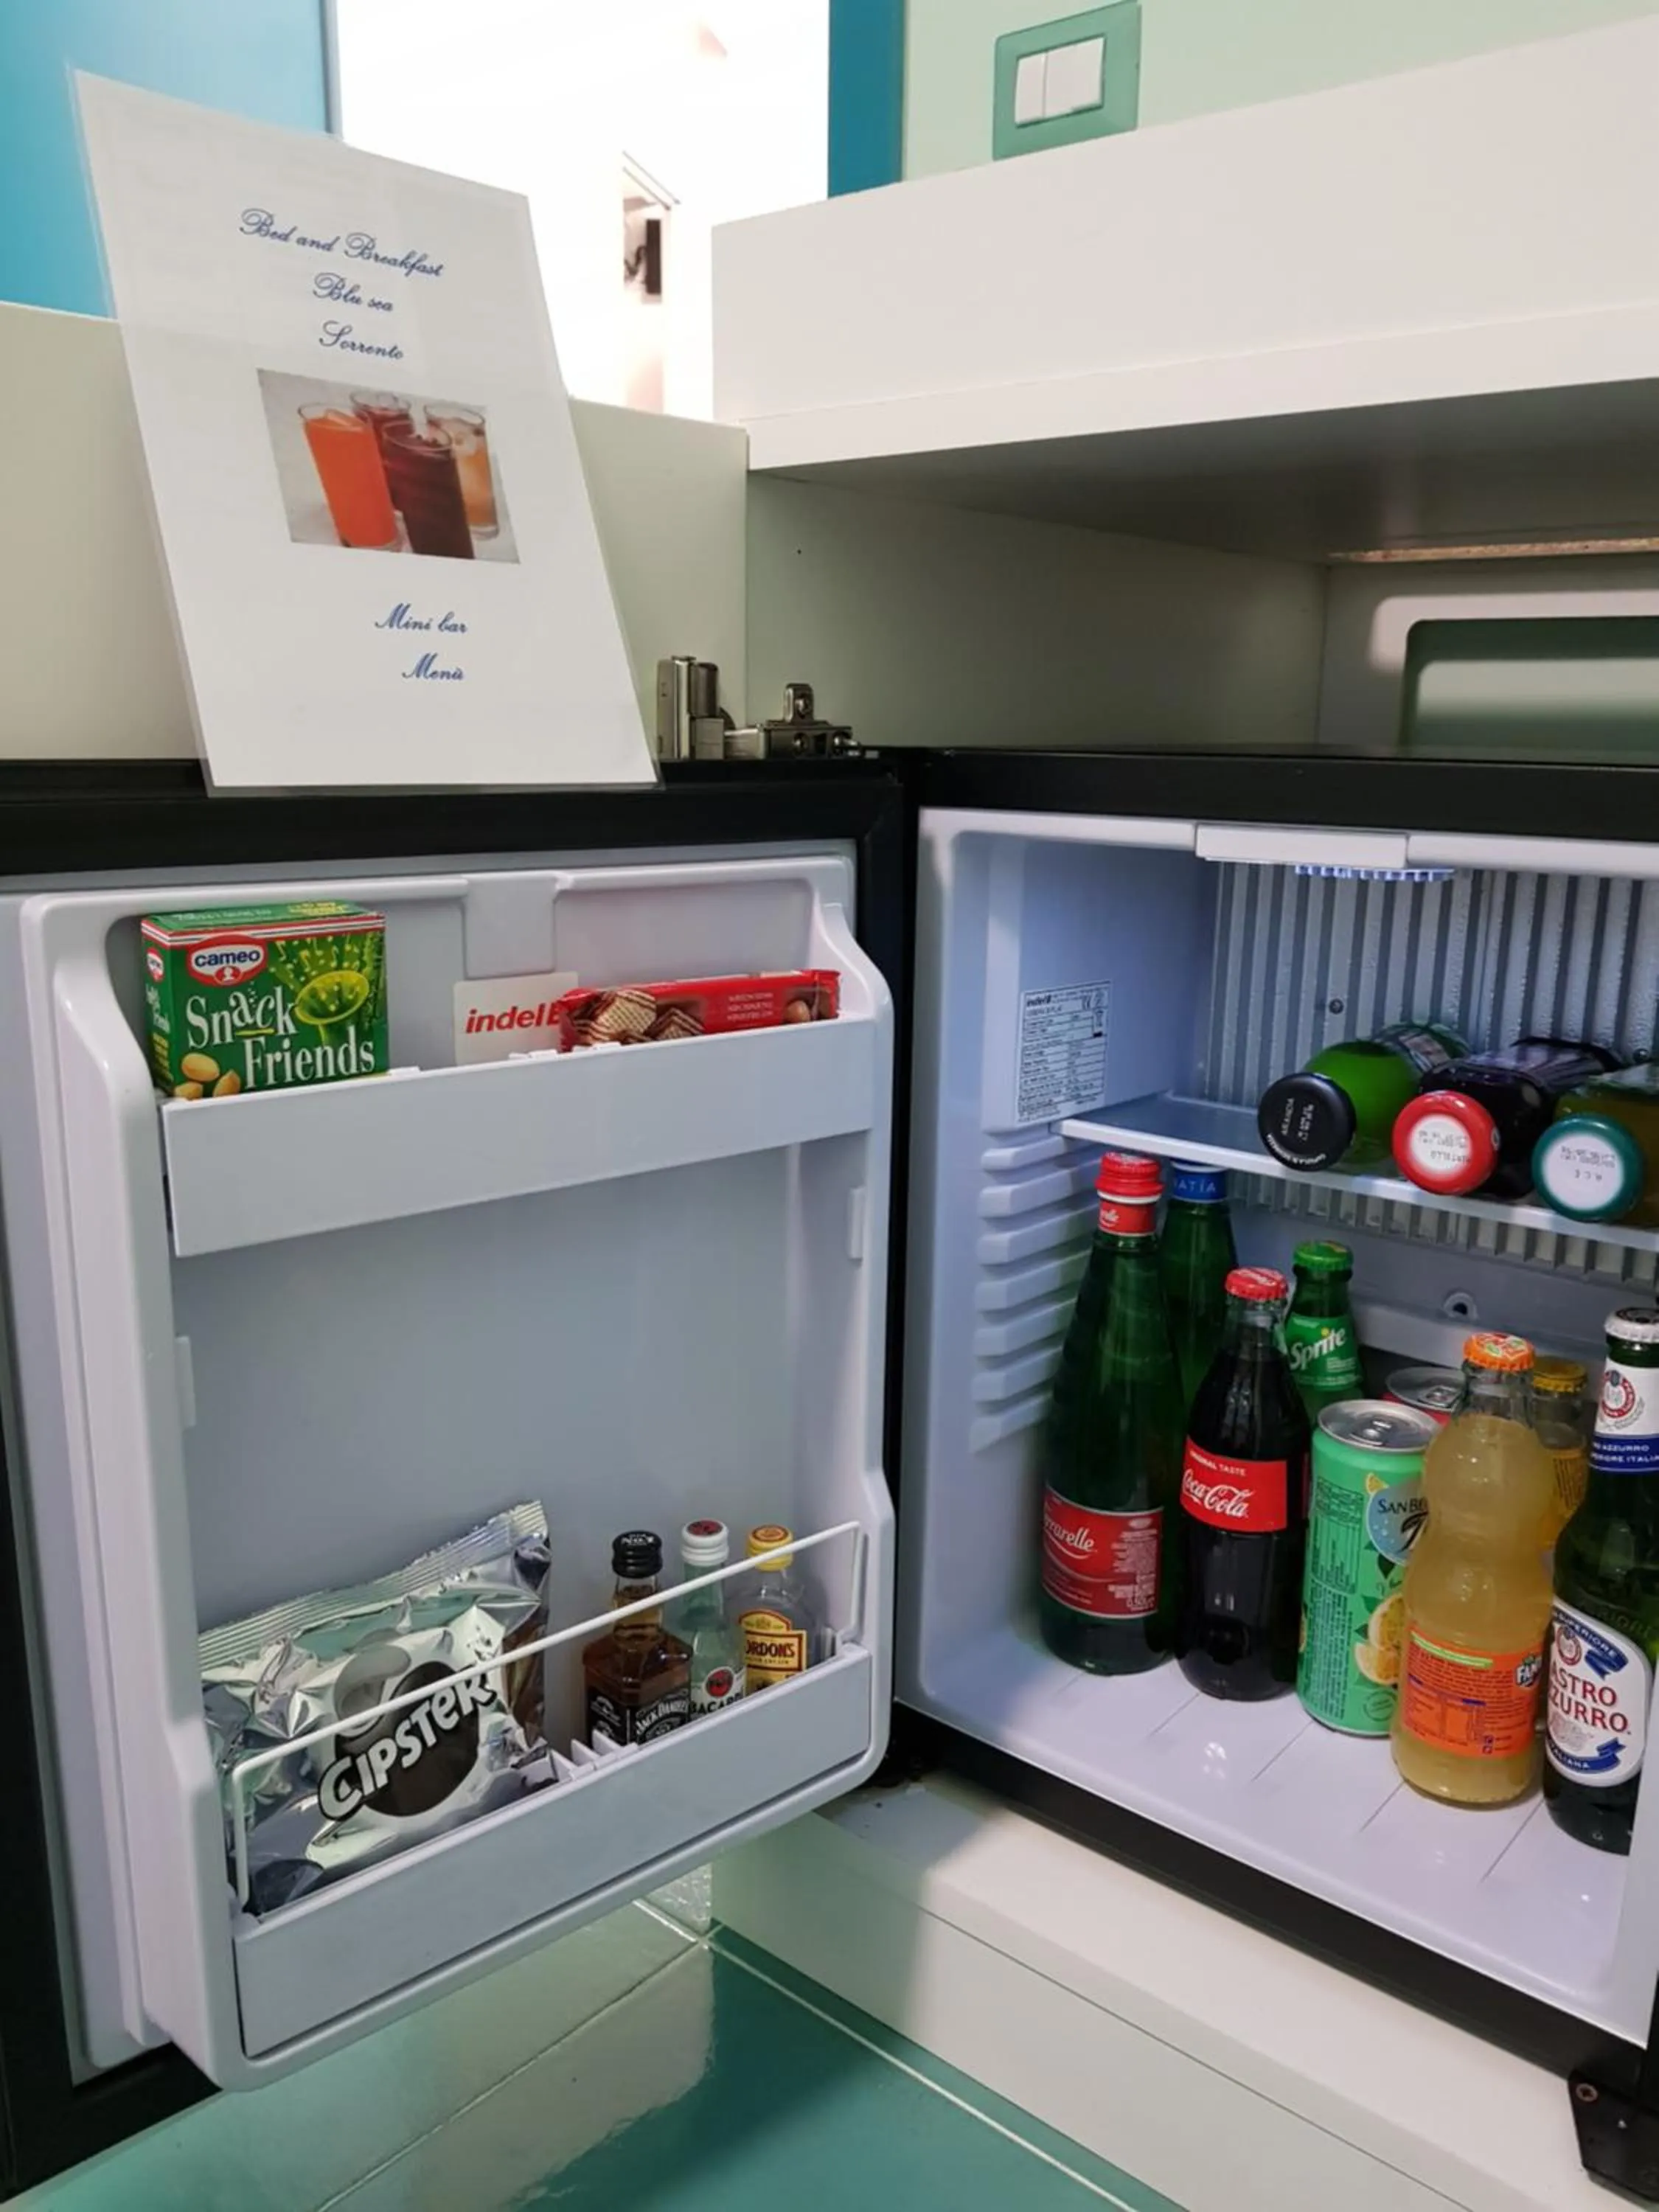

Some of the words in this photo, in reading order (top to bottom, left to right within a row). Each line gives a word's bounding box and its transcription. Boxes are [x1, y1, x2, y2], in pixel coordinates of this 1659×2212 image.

[240, 208, 297, 242] Bed
[296, 235, 341, 252] and
[344, 232, 444, 277] Breakfast
[313, 272, 363, 306] Blu
[367, 297, 394, 312] sea
[319, 320, 404, 360] Sorrento
[375, 602, 434, 630] Mini
[438, 611, 467, 633] bar
[195, 950, 260, 968] cameo
[187, 986, 297, 1049] Snack
[243, 1026, 375, 1090] Friends
[1290, 1327, 1346, 1370] Sprite
[1218, 1464, 1246, 1477] TASTE
[1550, 1661, 1618, 1707] ASTRO
